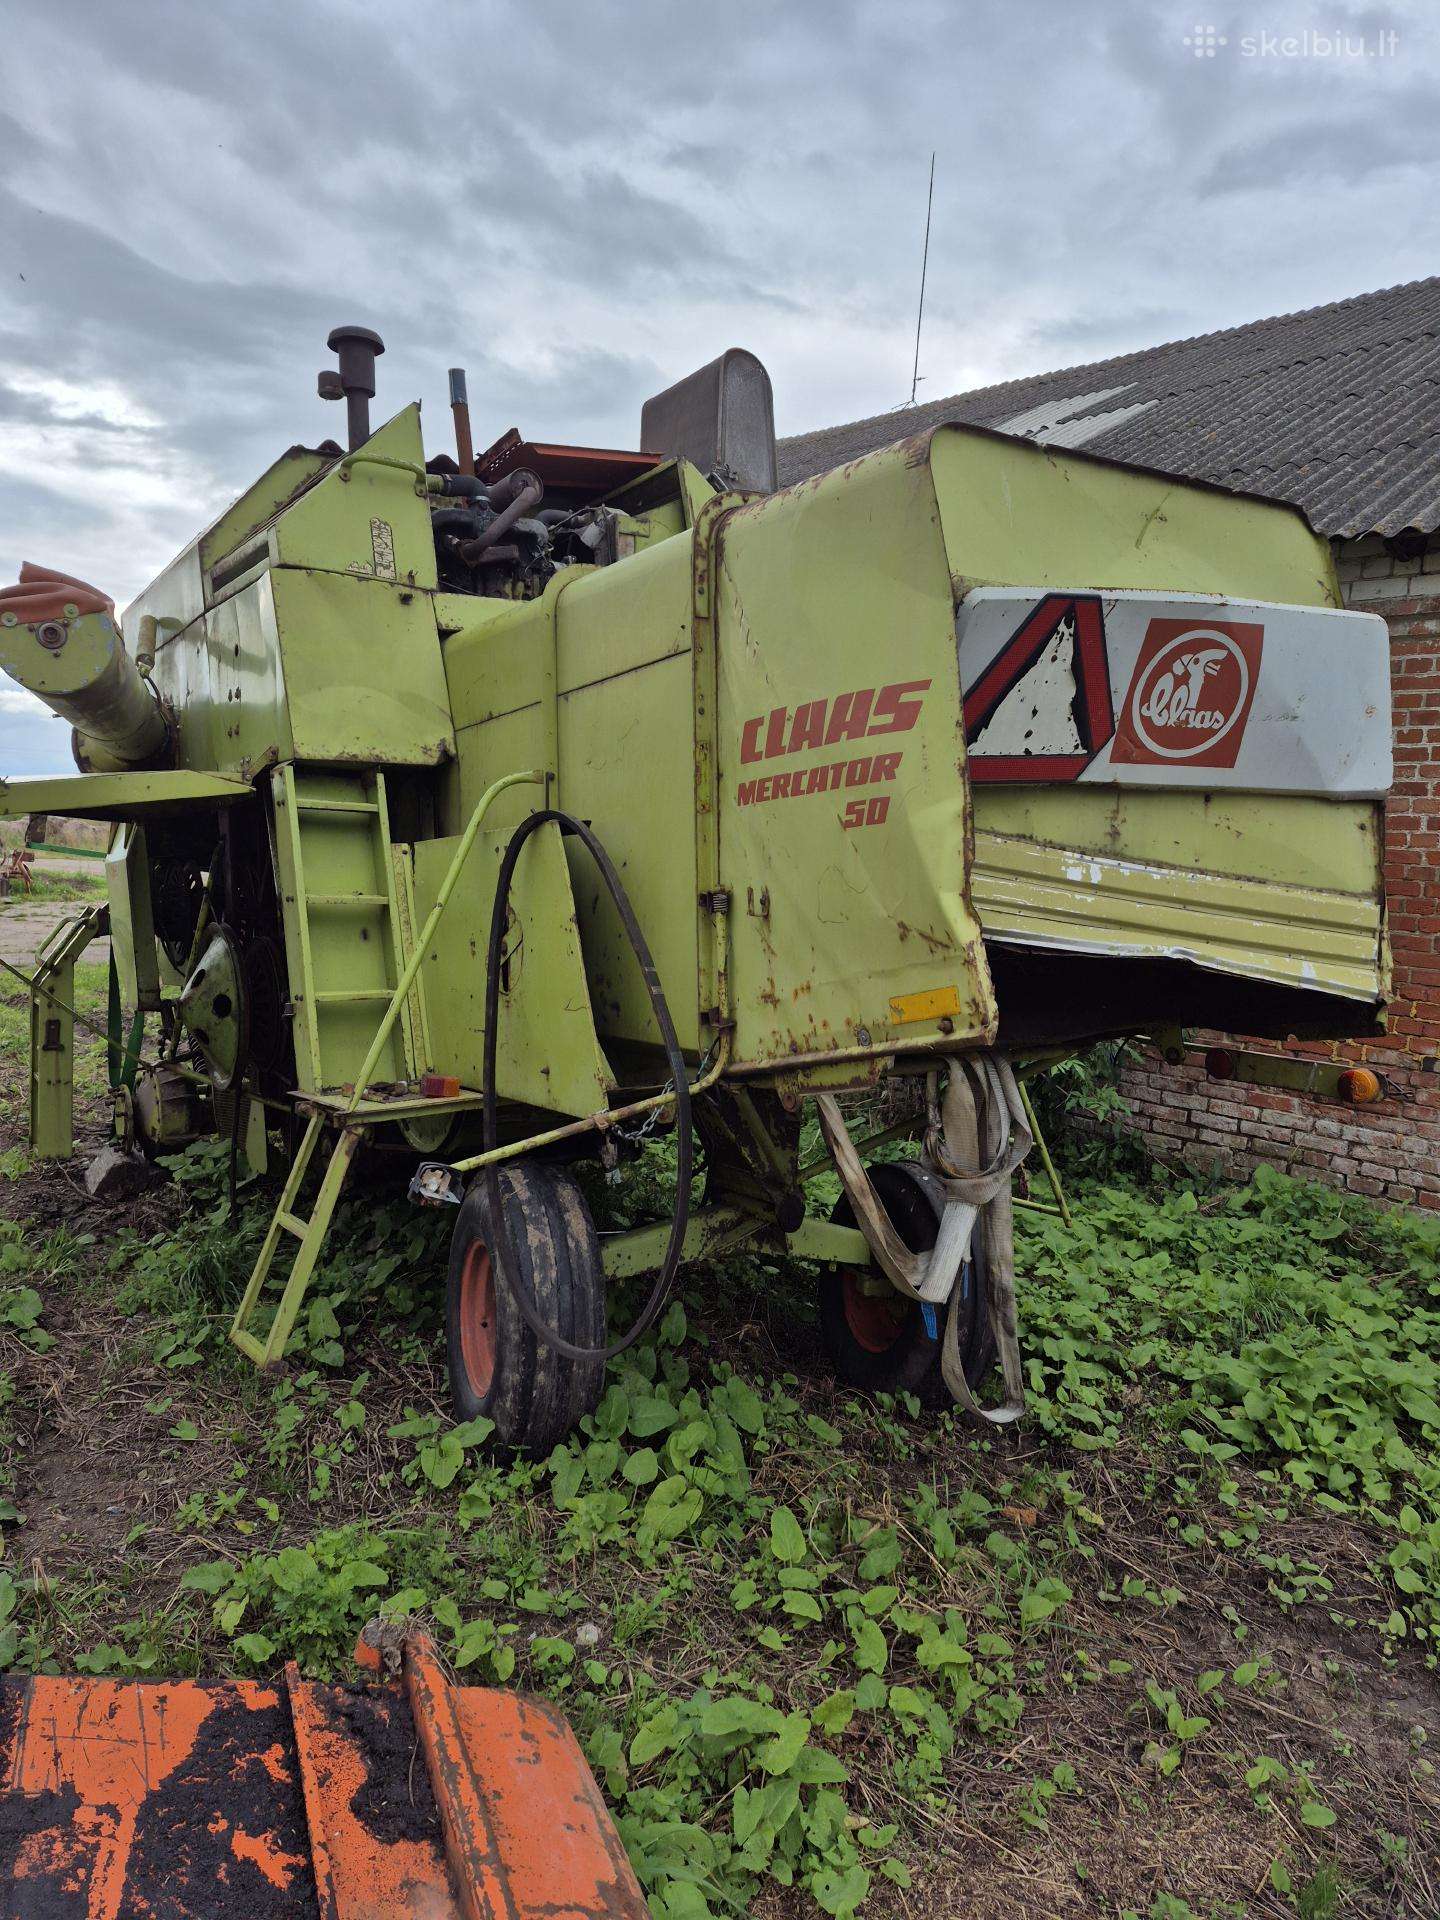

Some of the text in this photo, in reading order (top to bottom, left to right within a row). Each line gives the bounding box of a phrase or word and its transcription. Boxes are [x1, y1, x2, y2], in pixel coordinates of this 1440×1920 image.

[740, 678, 932, 764] CLAAS
[737, 752, 903, 806] MERCATOR
[844, 796, 891, 829] 50
